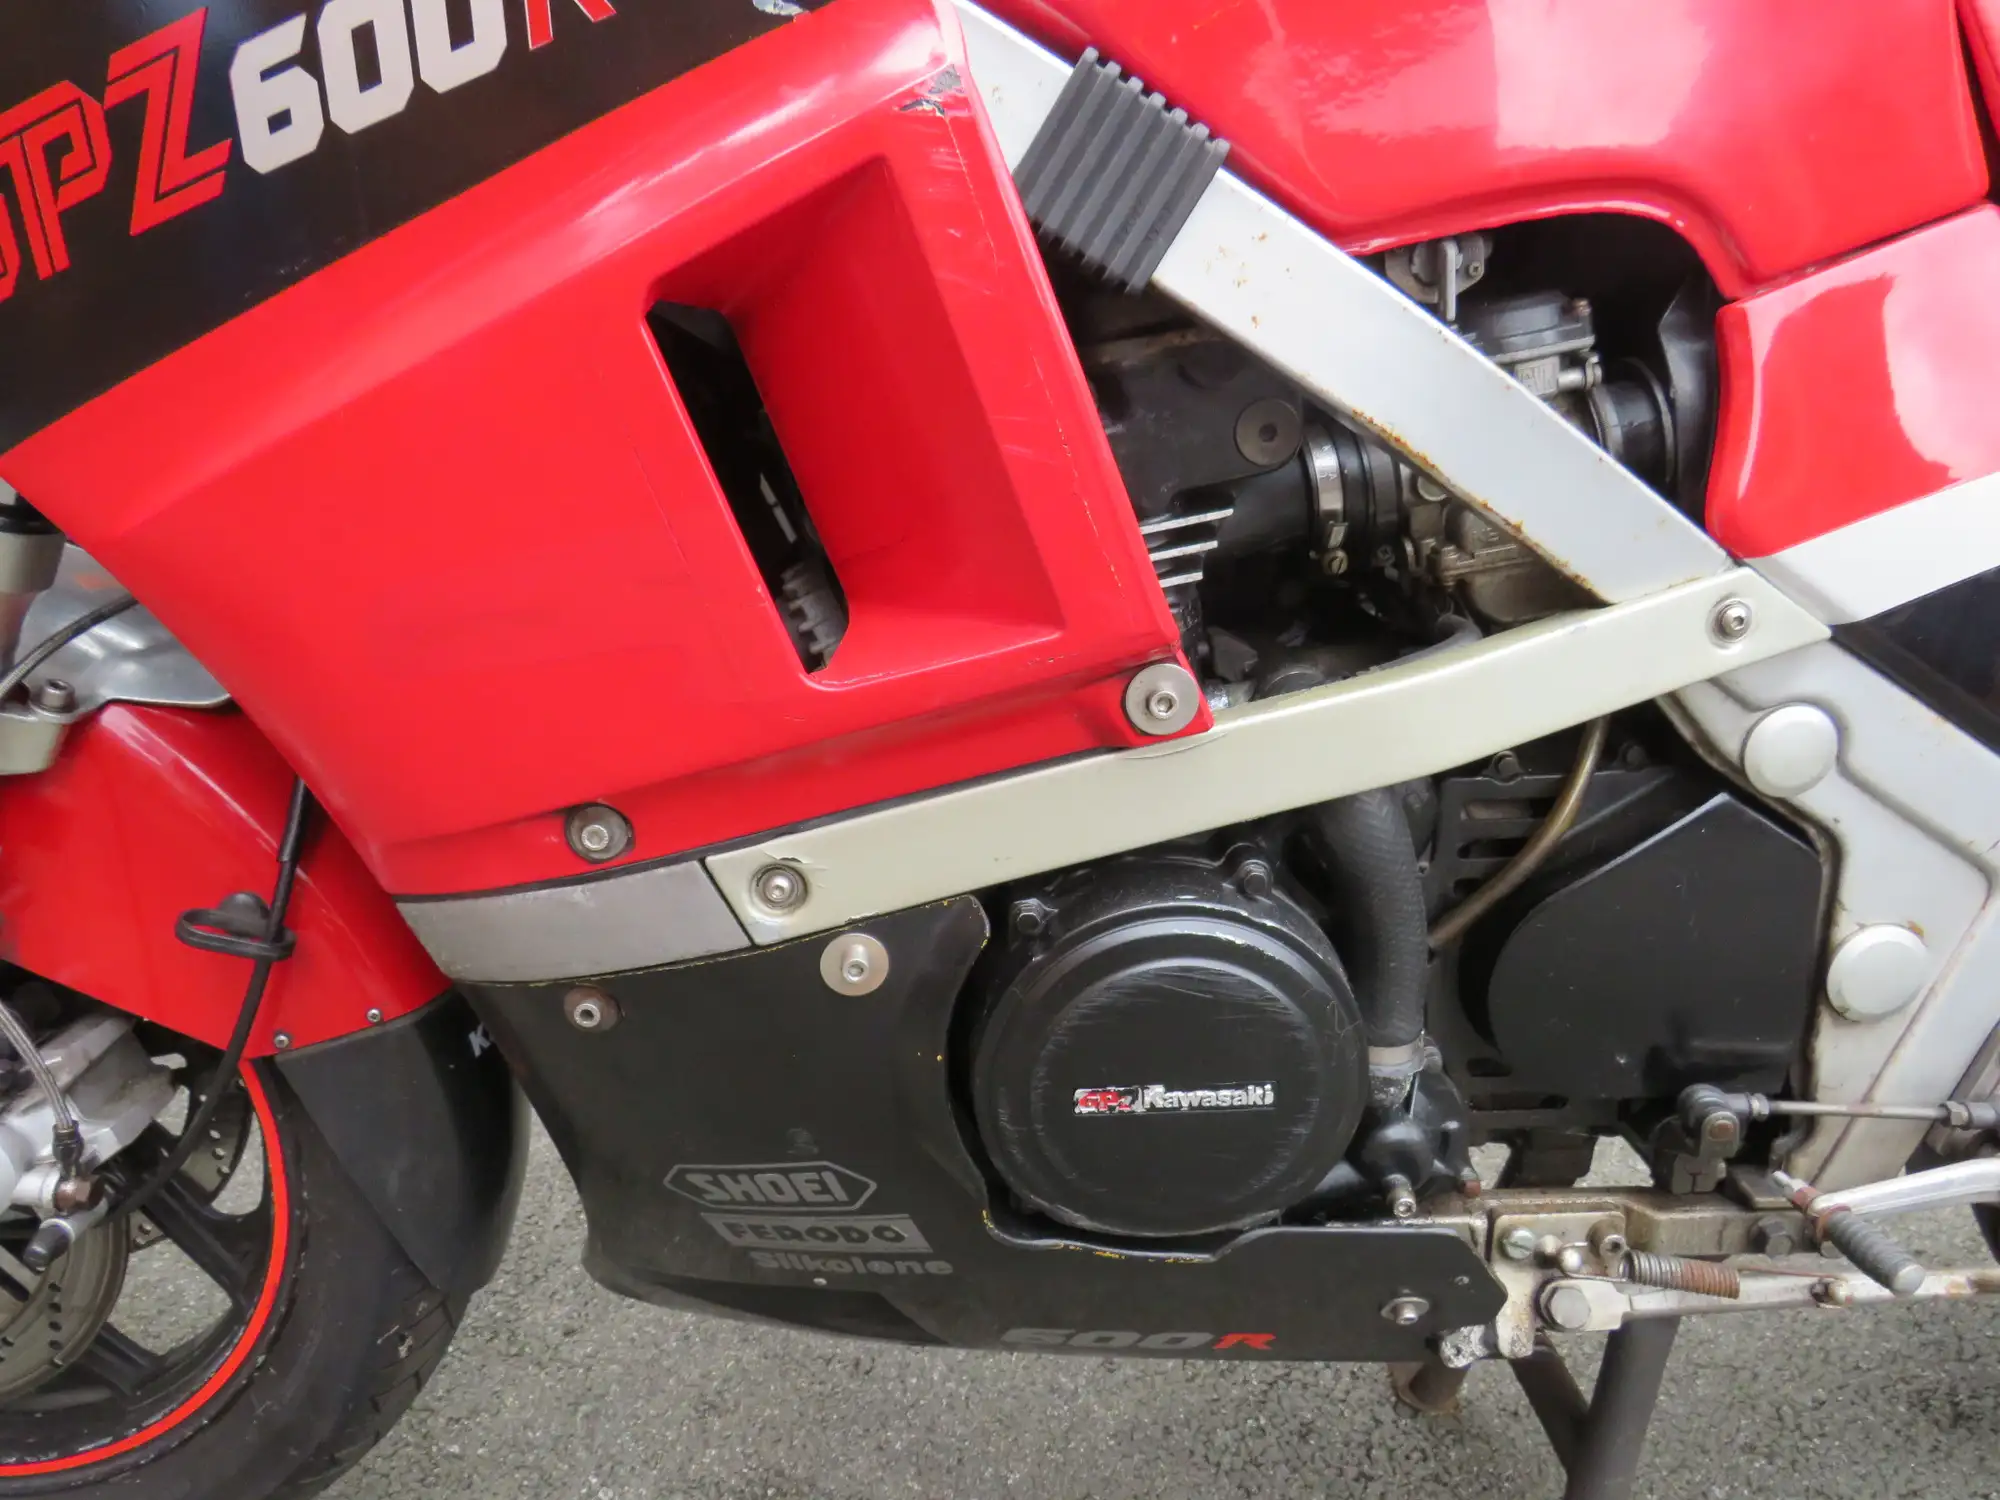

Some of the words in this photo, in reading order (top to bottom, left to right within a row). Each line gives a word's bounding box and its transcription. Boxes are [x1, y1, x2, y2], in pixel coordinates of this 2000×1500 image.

[1143, 1083, 1275, 1111] Kawasaki
[685, 1171, 850, 1203] SHOEI
[721, 1222, 910, 1244] FERODO
[1000, 1327, 1276, 1350] 600R
